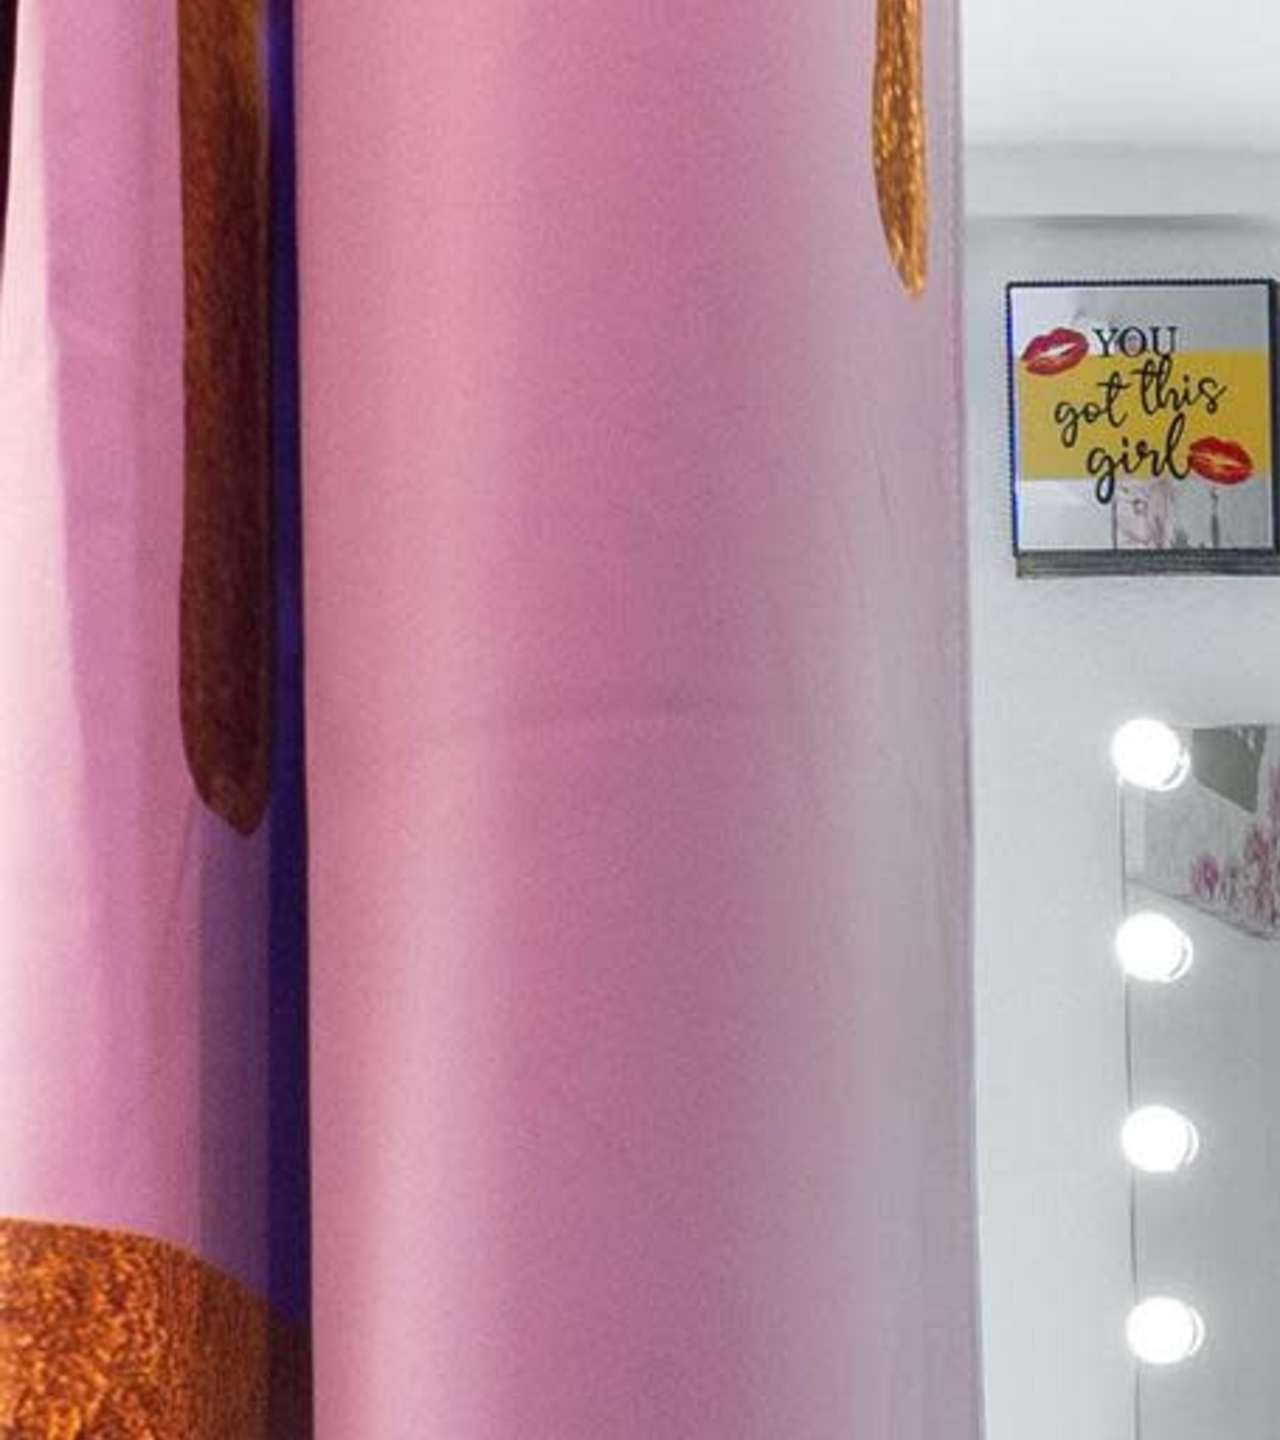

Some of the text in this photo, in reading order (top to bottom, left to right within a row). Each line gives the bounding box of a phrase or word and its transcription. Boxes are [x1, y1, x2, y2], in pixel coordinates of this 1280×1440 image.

[1092, 325, 1178, 357] YOU
[1054, 353, 1228, 448] got this
[1086, 412, 1192, 504] girl
